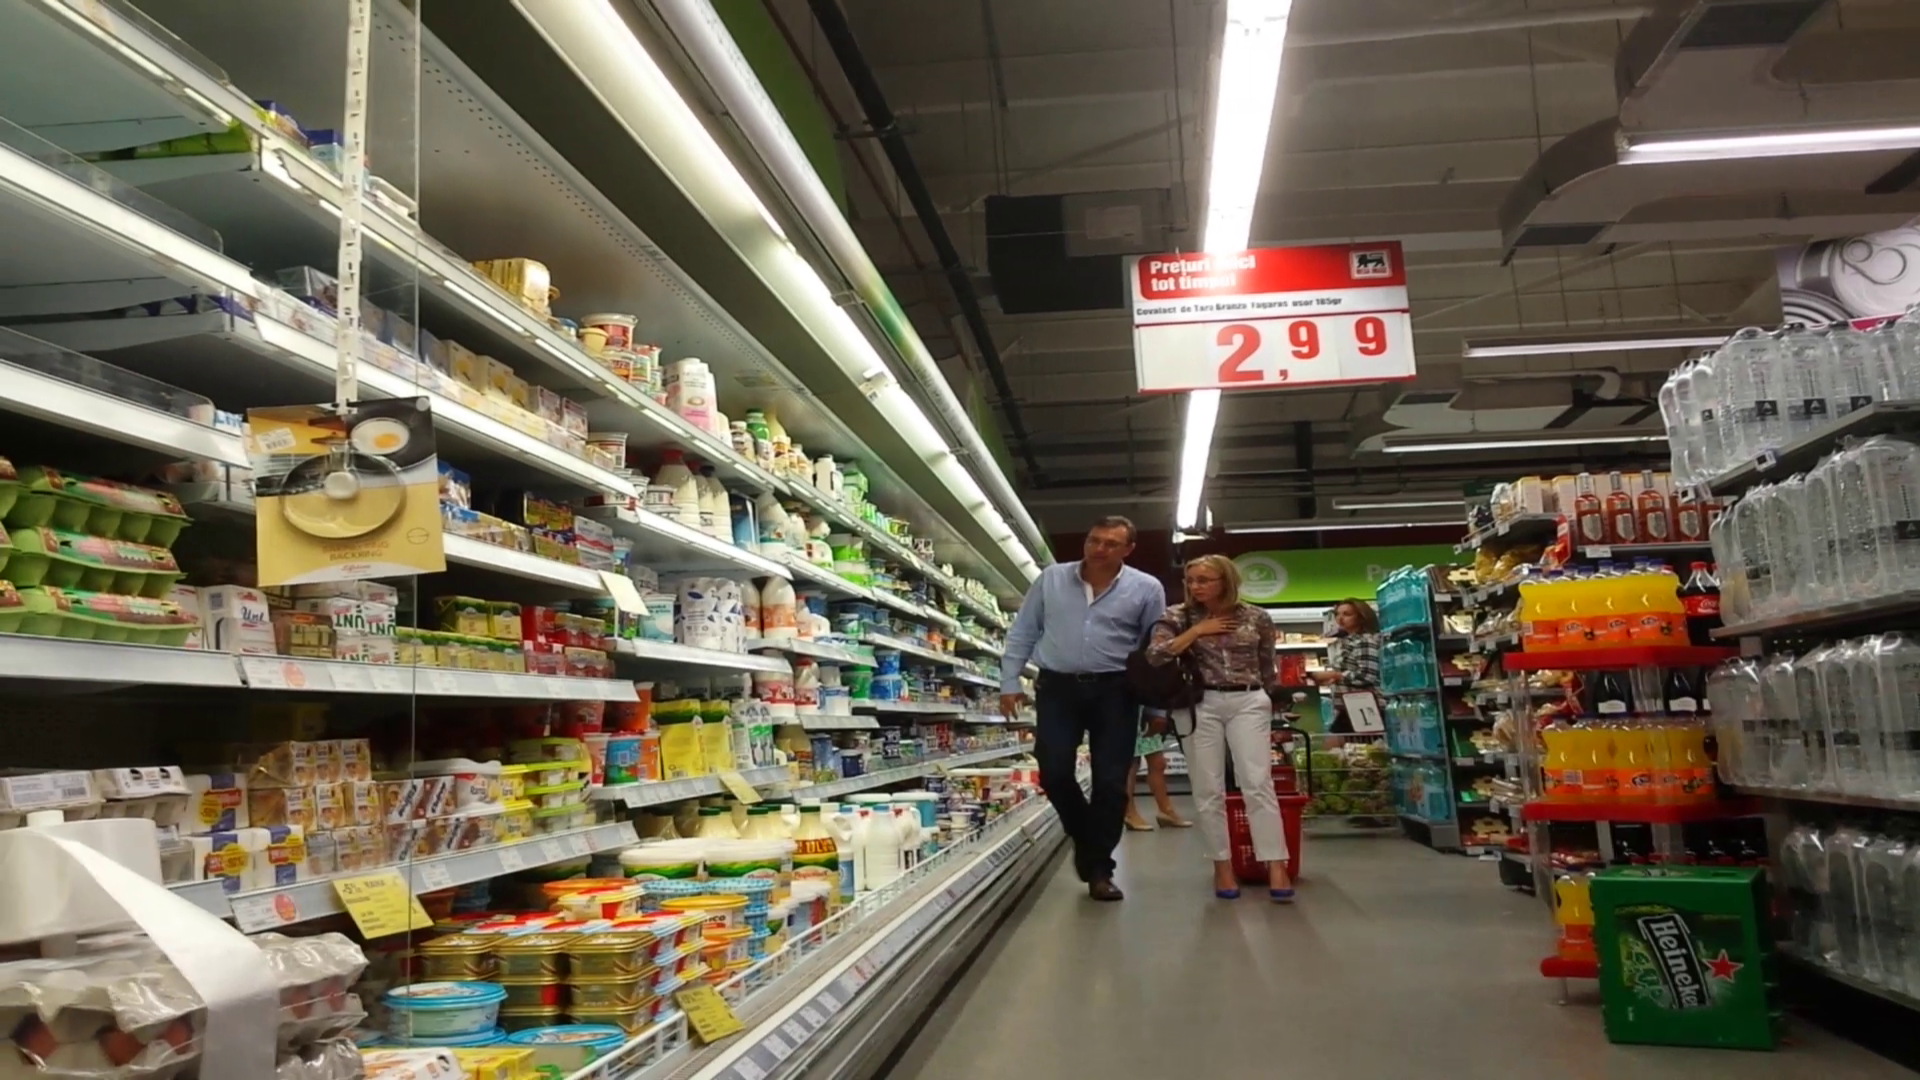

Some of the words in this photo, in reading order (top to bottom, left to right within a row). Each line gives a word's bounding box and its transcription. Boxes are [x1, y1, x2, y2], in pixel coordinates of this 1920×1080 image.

[1151, 277, 1176, 292] tot
[1136, 306, 1177, 316] Covalact
[1180, 305, 1192, 313] de
[1292, 299, 1313, 307] usor
[334, 614, 365, 629] UNT
